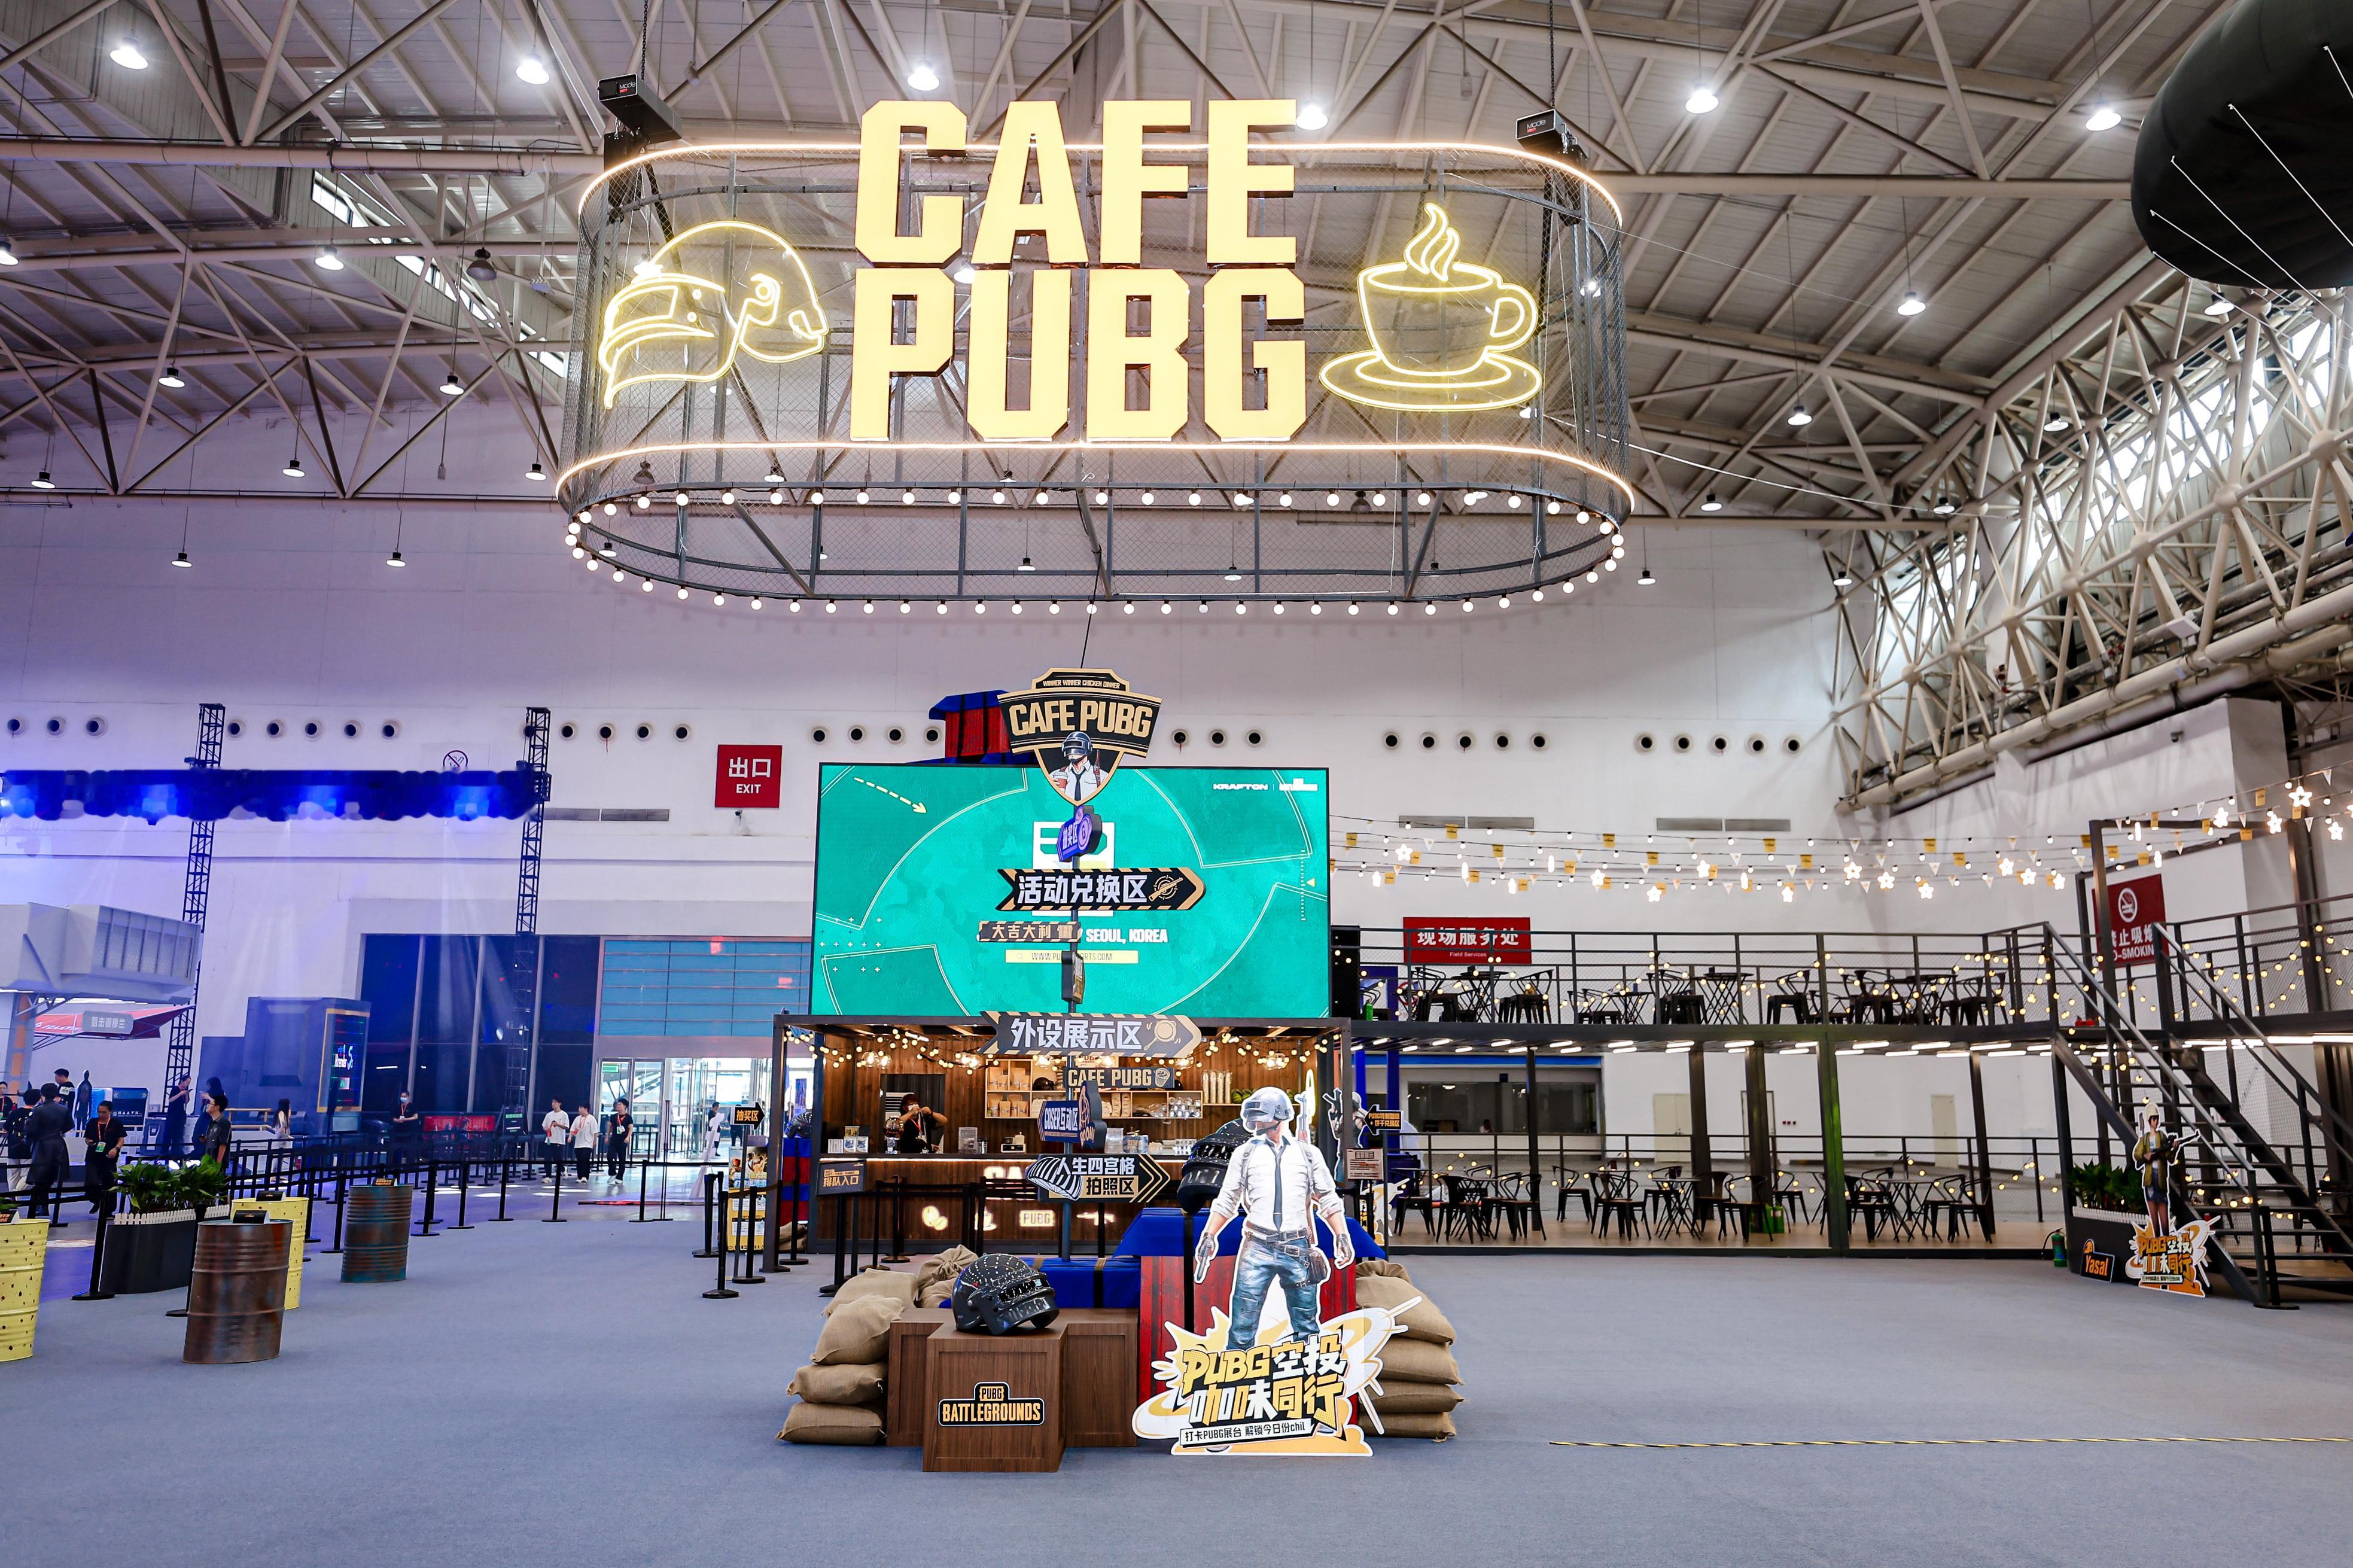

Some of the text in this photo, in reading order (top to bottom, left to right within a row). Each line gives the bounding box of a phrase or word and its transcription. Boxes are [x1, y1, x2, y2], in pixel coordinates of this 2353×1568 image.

[855, 99, 1297, 265] CAFE
[850, 267, 1307, 442] PUBG
[1103, 681, 1121, 689] DINNER
[1009, 699, 1153, 738] CAFE PUBG
[728, 757, 771, 778] 出口
[736, 784, 762, 794] EXIT
[1017, 875, 1147, 904] 活动兑换区
[992, 924, 1052, 939] 大吉大利
[1085, 928, 1168, 945] SEOUL, KOREA
[1417, 927, 1520, 946] 现场服务处
[1010, 1018, 1142, 1050] 外设展示区
[1068, 1068, 1152, 1086] CAFE PUBG
[736, 1110, 759, 1122] 抽奖区
[1044, 1107, 1079, 1131] COSER互动区
[1056, 1157, 1135, 1176] 人生四宫格
[823, 1175, 859, 1188] 排队入口
[1086, 1177, 1135, 1195] 拍照区
[1023, 1213, 1051, 1225] PUBG
[1182, 1333, 1347, 1396] PUBG空投
[981, 1388, 1003, 1400] PUBG
[1189, 1375, 1344, 1429] 咖味同行
[942, 1402, 1041, 1422] BATTLEGROUNDS
[1185, 1427, 1242, 1442] 打卡PUBG展台
